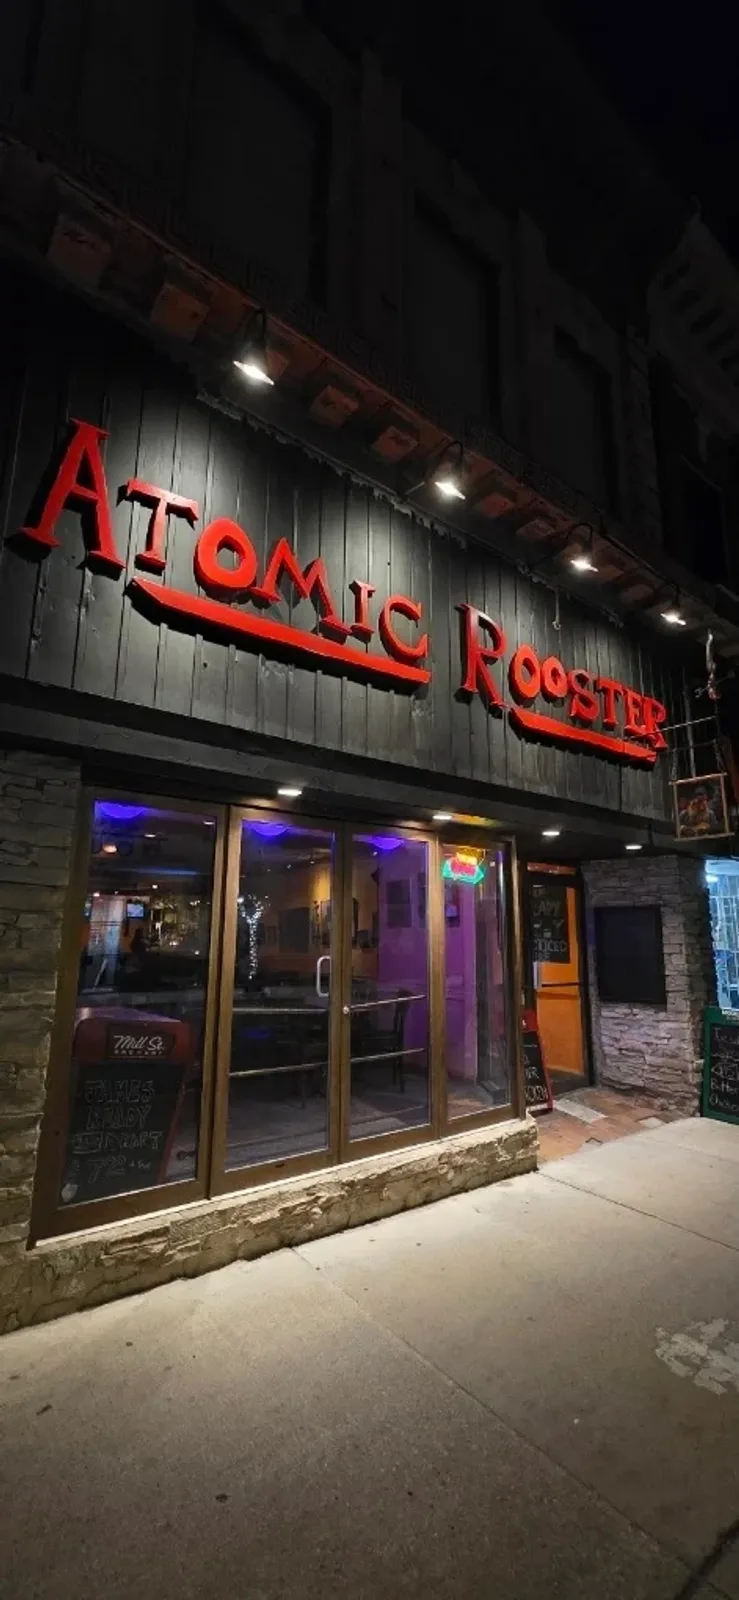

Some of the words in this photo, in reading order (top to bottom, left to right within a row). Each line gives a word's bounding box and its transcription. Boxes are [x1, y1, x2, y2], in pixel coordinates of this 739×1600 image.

[18, 417, 429, 662] ATOMIC
[455, 603, 668, 753] ROOSTER
[113, 1035, 149, 1049] Mill
